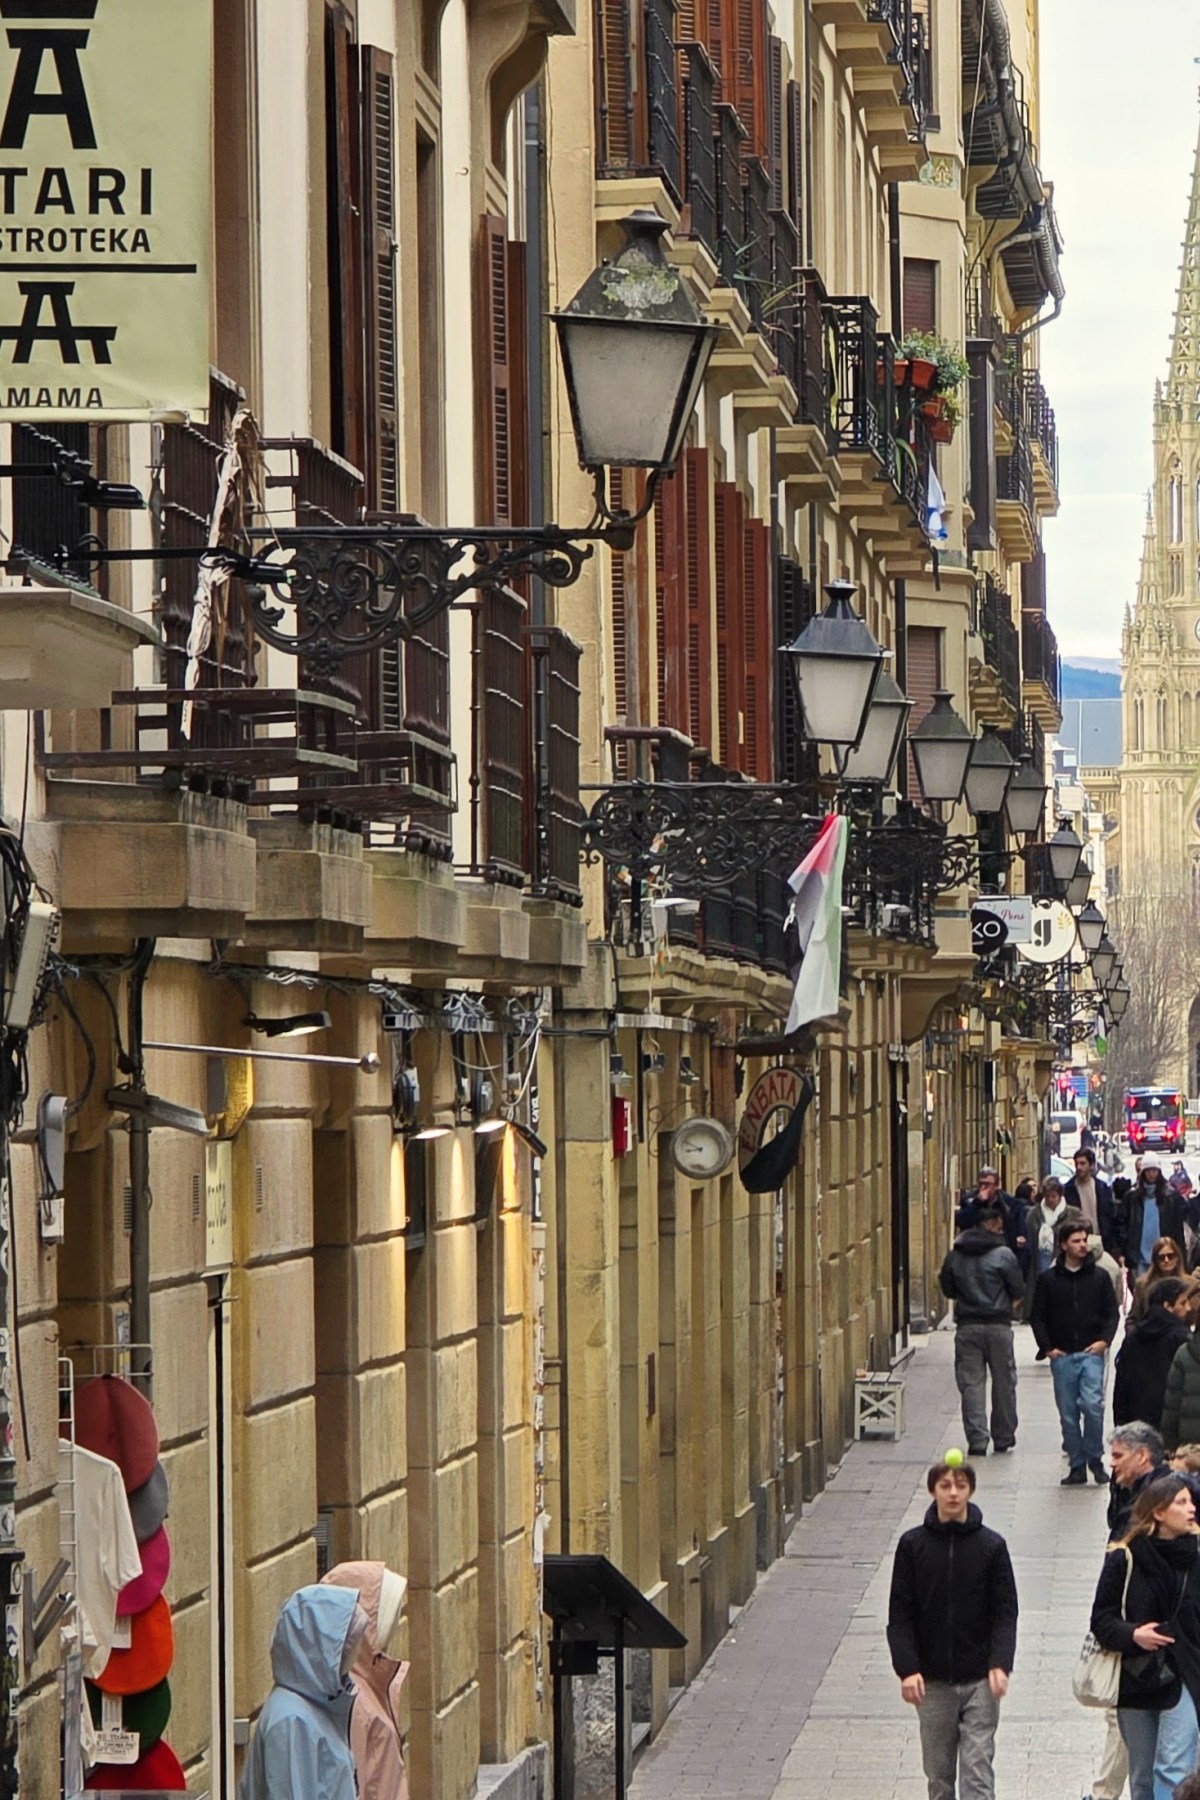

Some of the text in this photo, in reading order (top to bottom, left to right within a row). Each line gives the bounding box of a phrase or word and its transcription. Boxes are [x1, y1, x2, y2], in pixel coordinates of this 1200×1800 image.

[0, 167, 152, 215] TARI
[0, 228, 151, 253] TROTEKA
[0, 387, 103, 408] MAMA
